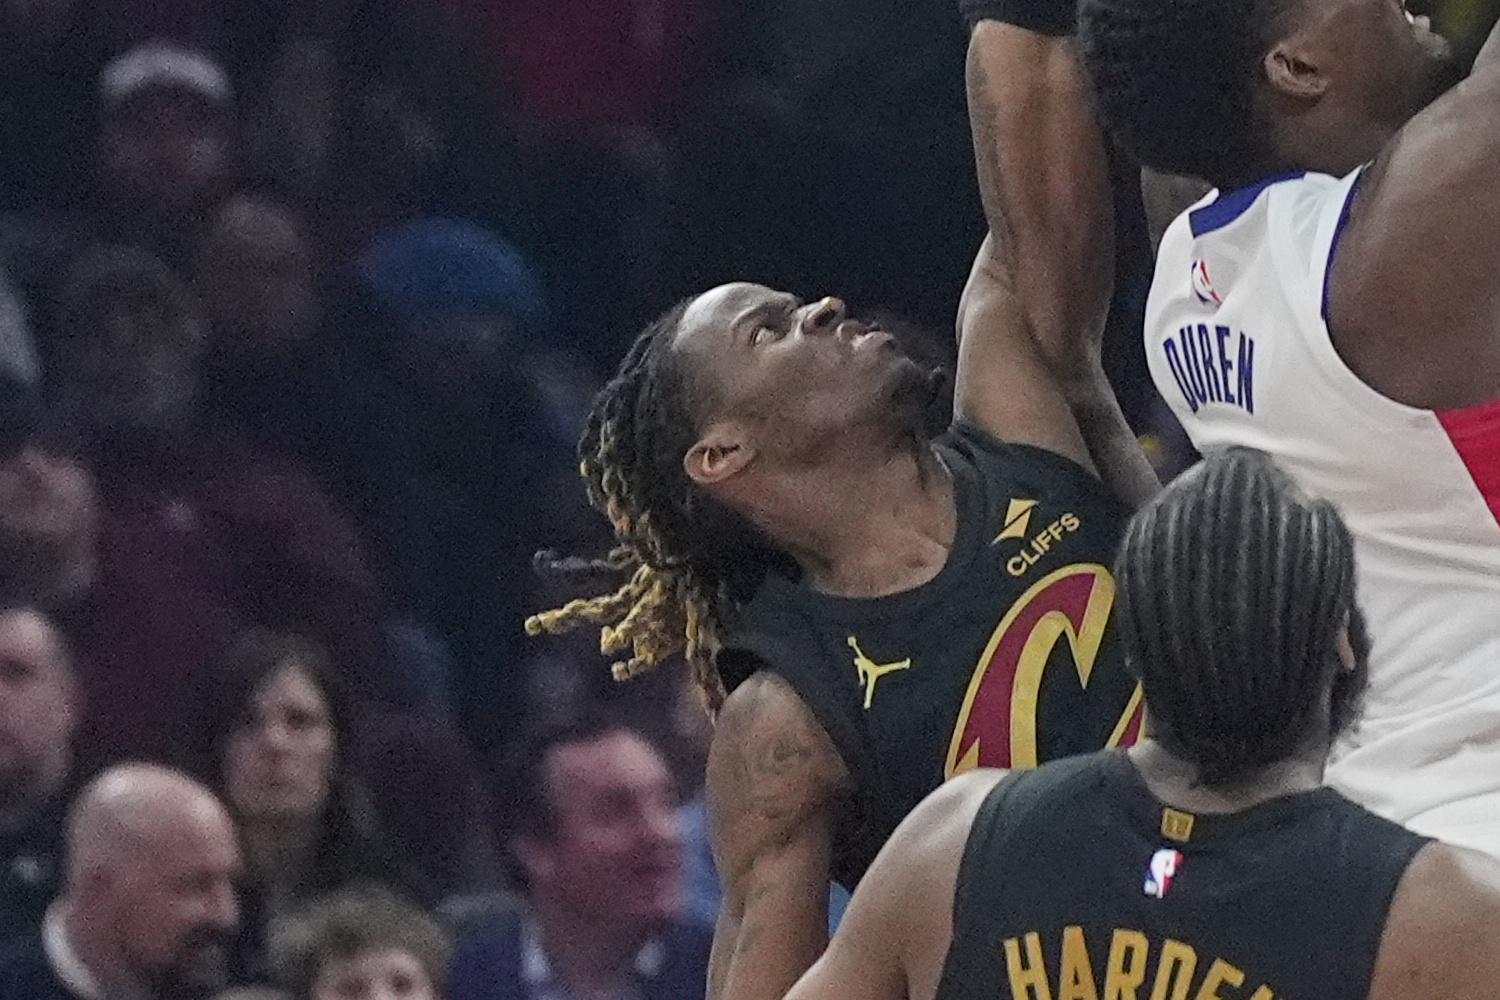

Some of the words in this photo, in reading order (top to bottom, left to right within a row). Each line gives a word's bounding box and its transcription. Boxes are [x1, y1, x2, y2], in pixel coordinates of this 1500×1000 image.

[1163, 324, 1254, 416] DUREN
[1006, 512, 1080, 577] CLIFFS
[1004, 925, 1278, 1000] HARDE
